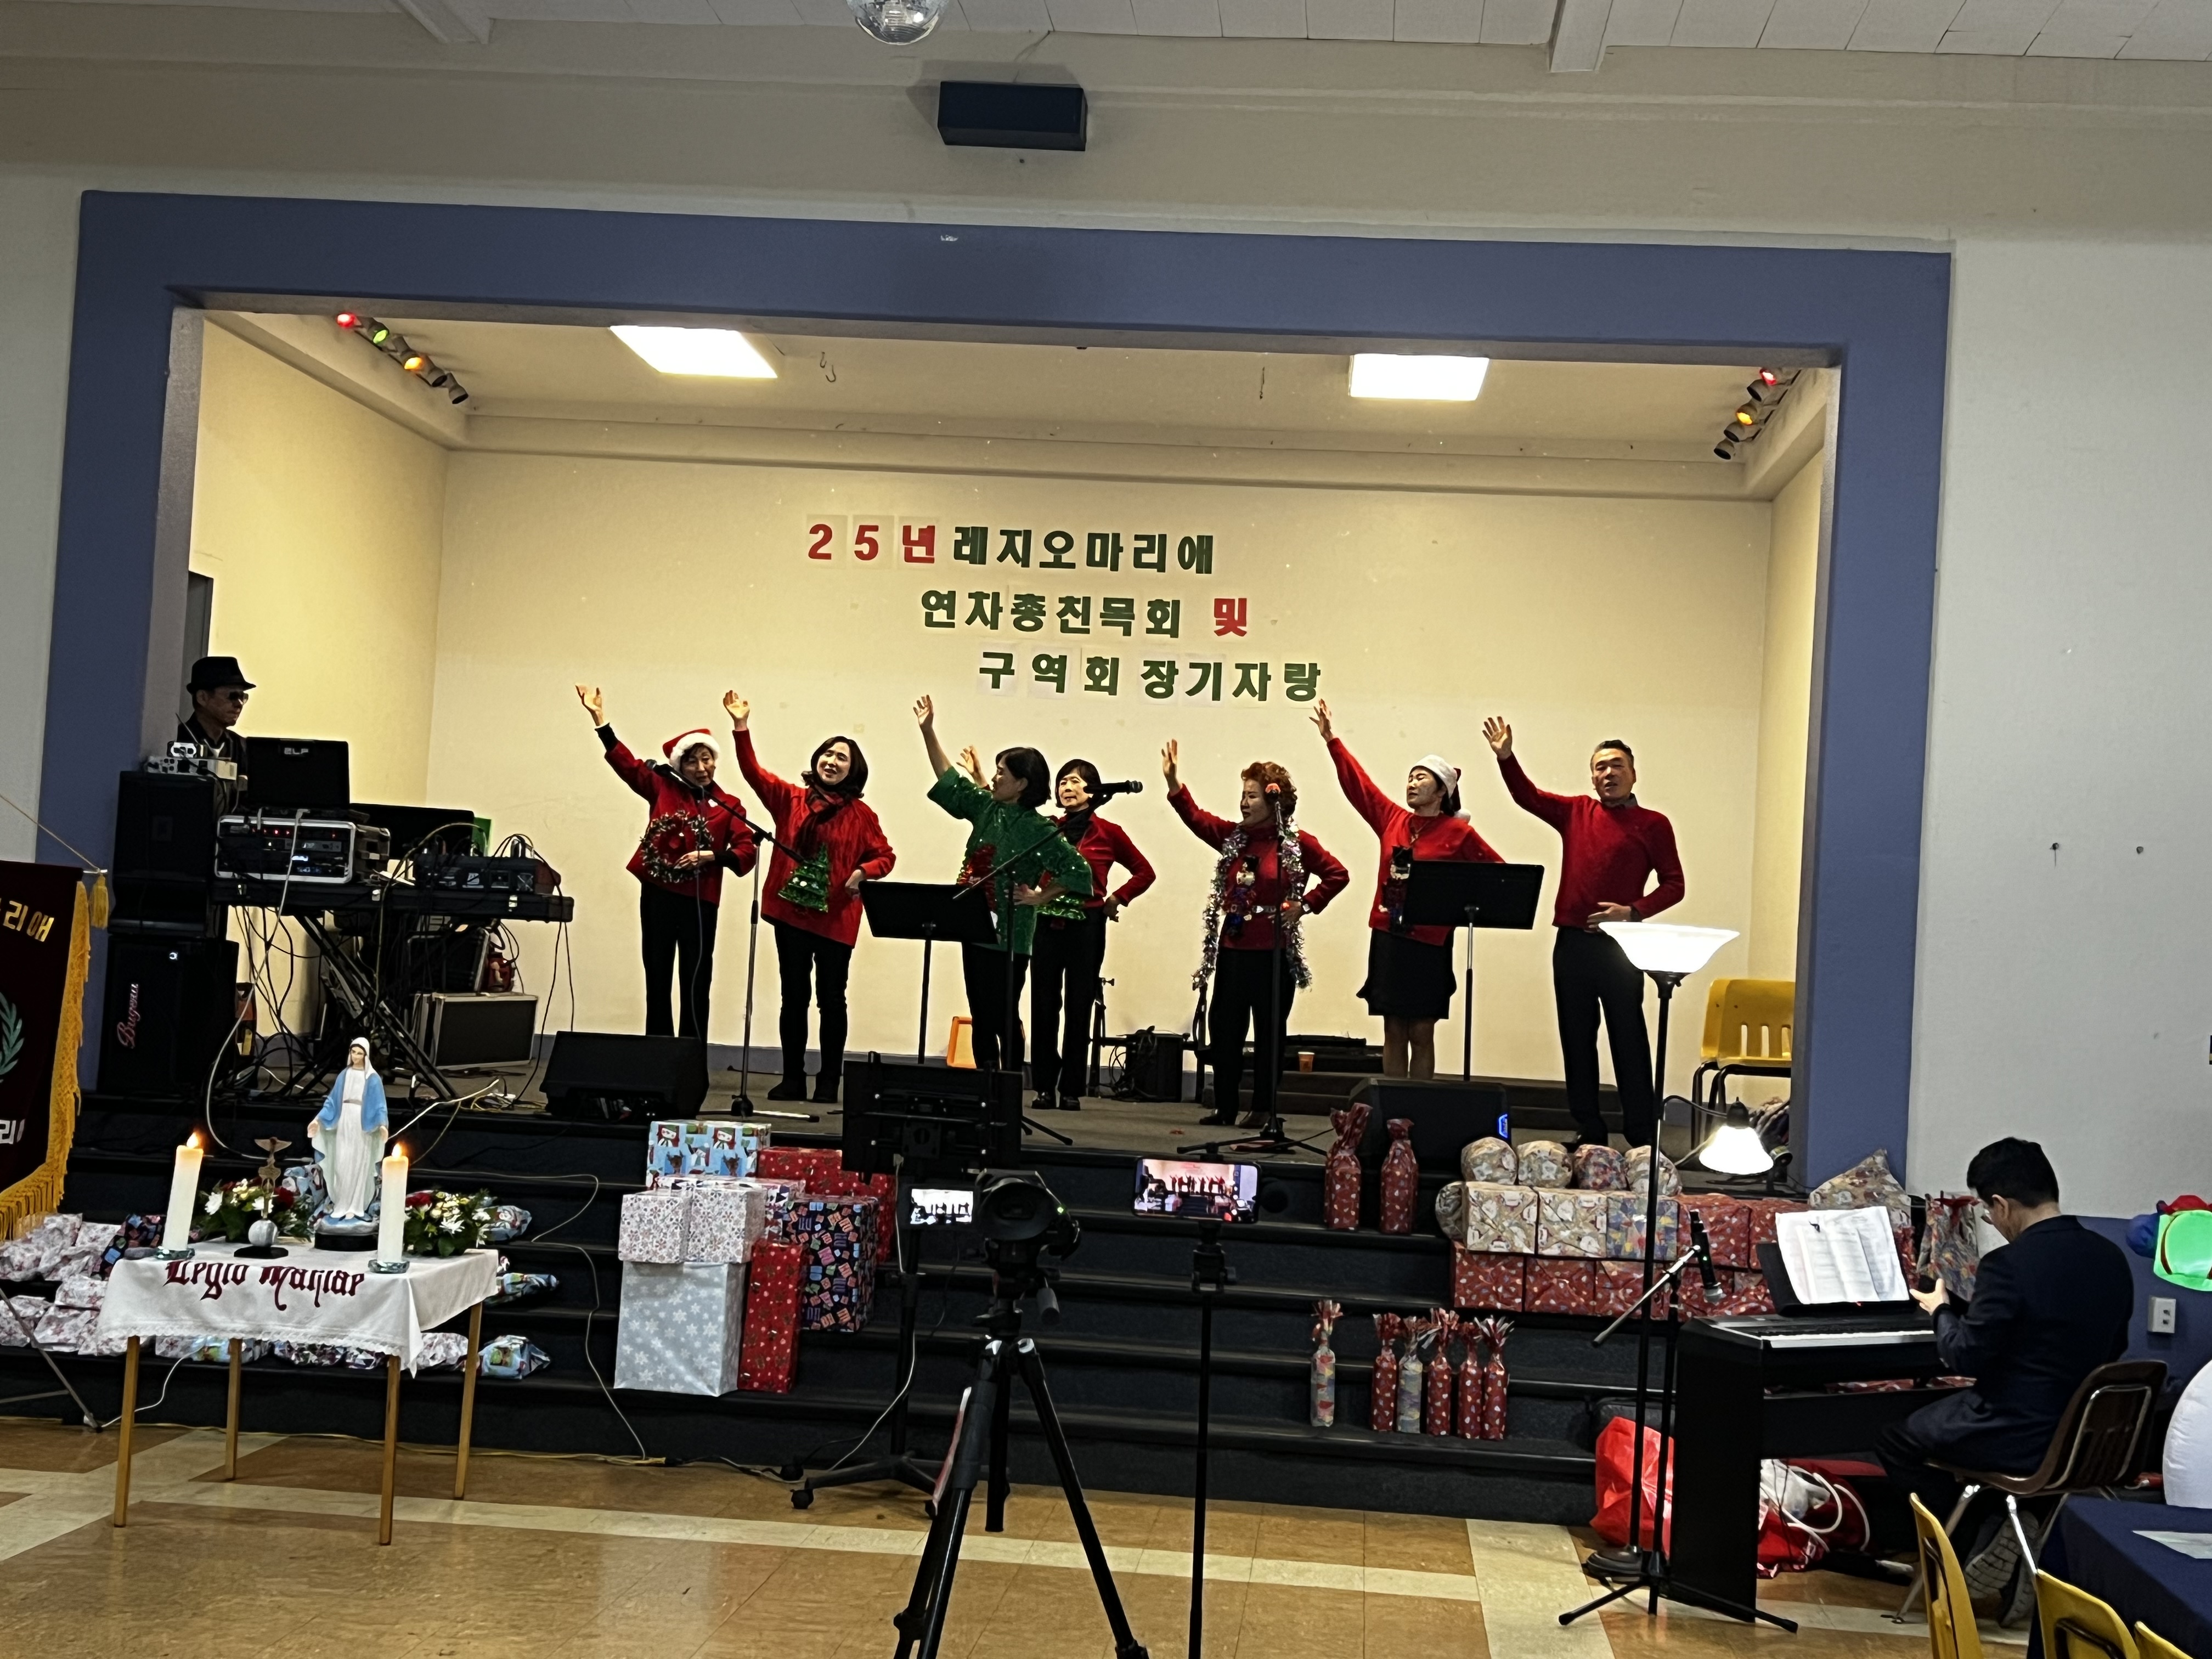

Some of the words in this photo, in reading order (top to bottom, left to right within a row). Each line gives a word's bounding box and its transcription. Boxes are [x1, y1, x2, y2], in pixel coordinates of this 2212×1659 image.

[808, 523, 935, 564] 25년
[953, 526, 1214, 574] 레지오마리애
[921, 589, 1181, 639] 연차총친목회
[1213, 597, 1248, 637] 및
[979, 651, 1120, 696] 구역회
[1141, 659, 1321, 702] 장기자랑
[0, 898, 55, 943] 리애
[162, 1260, 251, 1301] Legio
